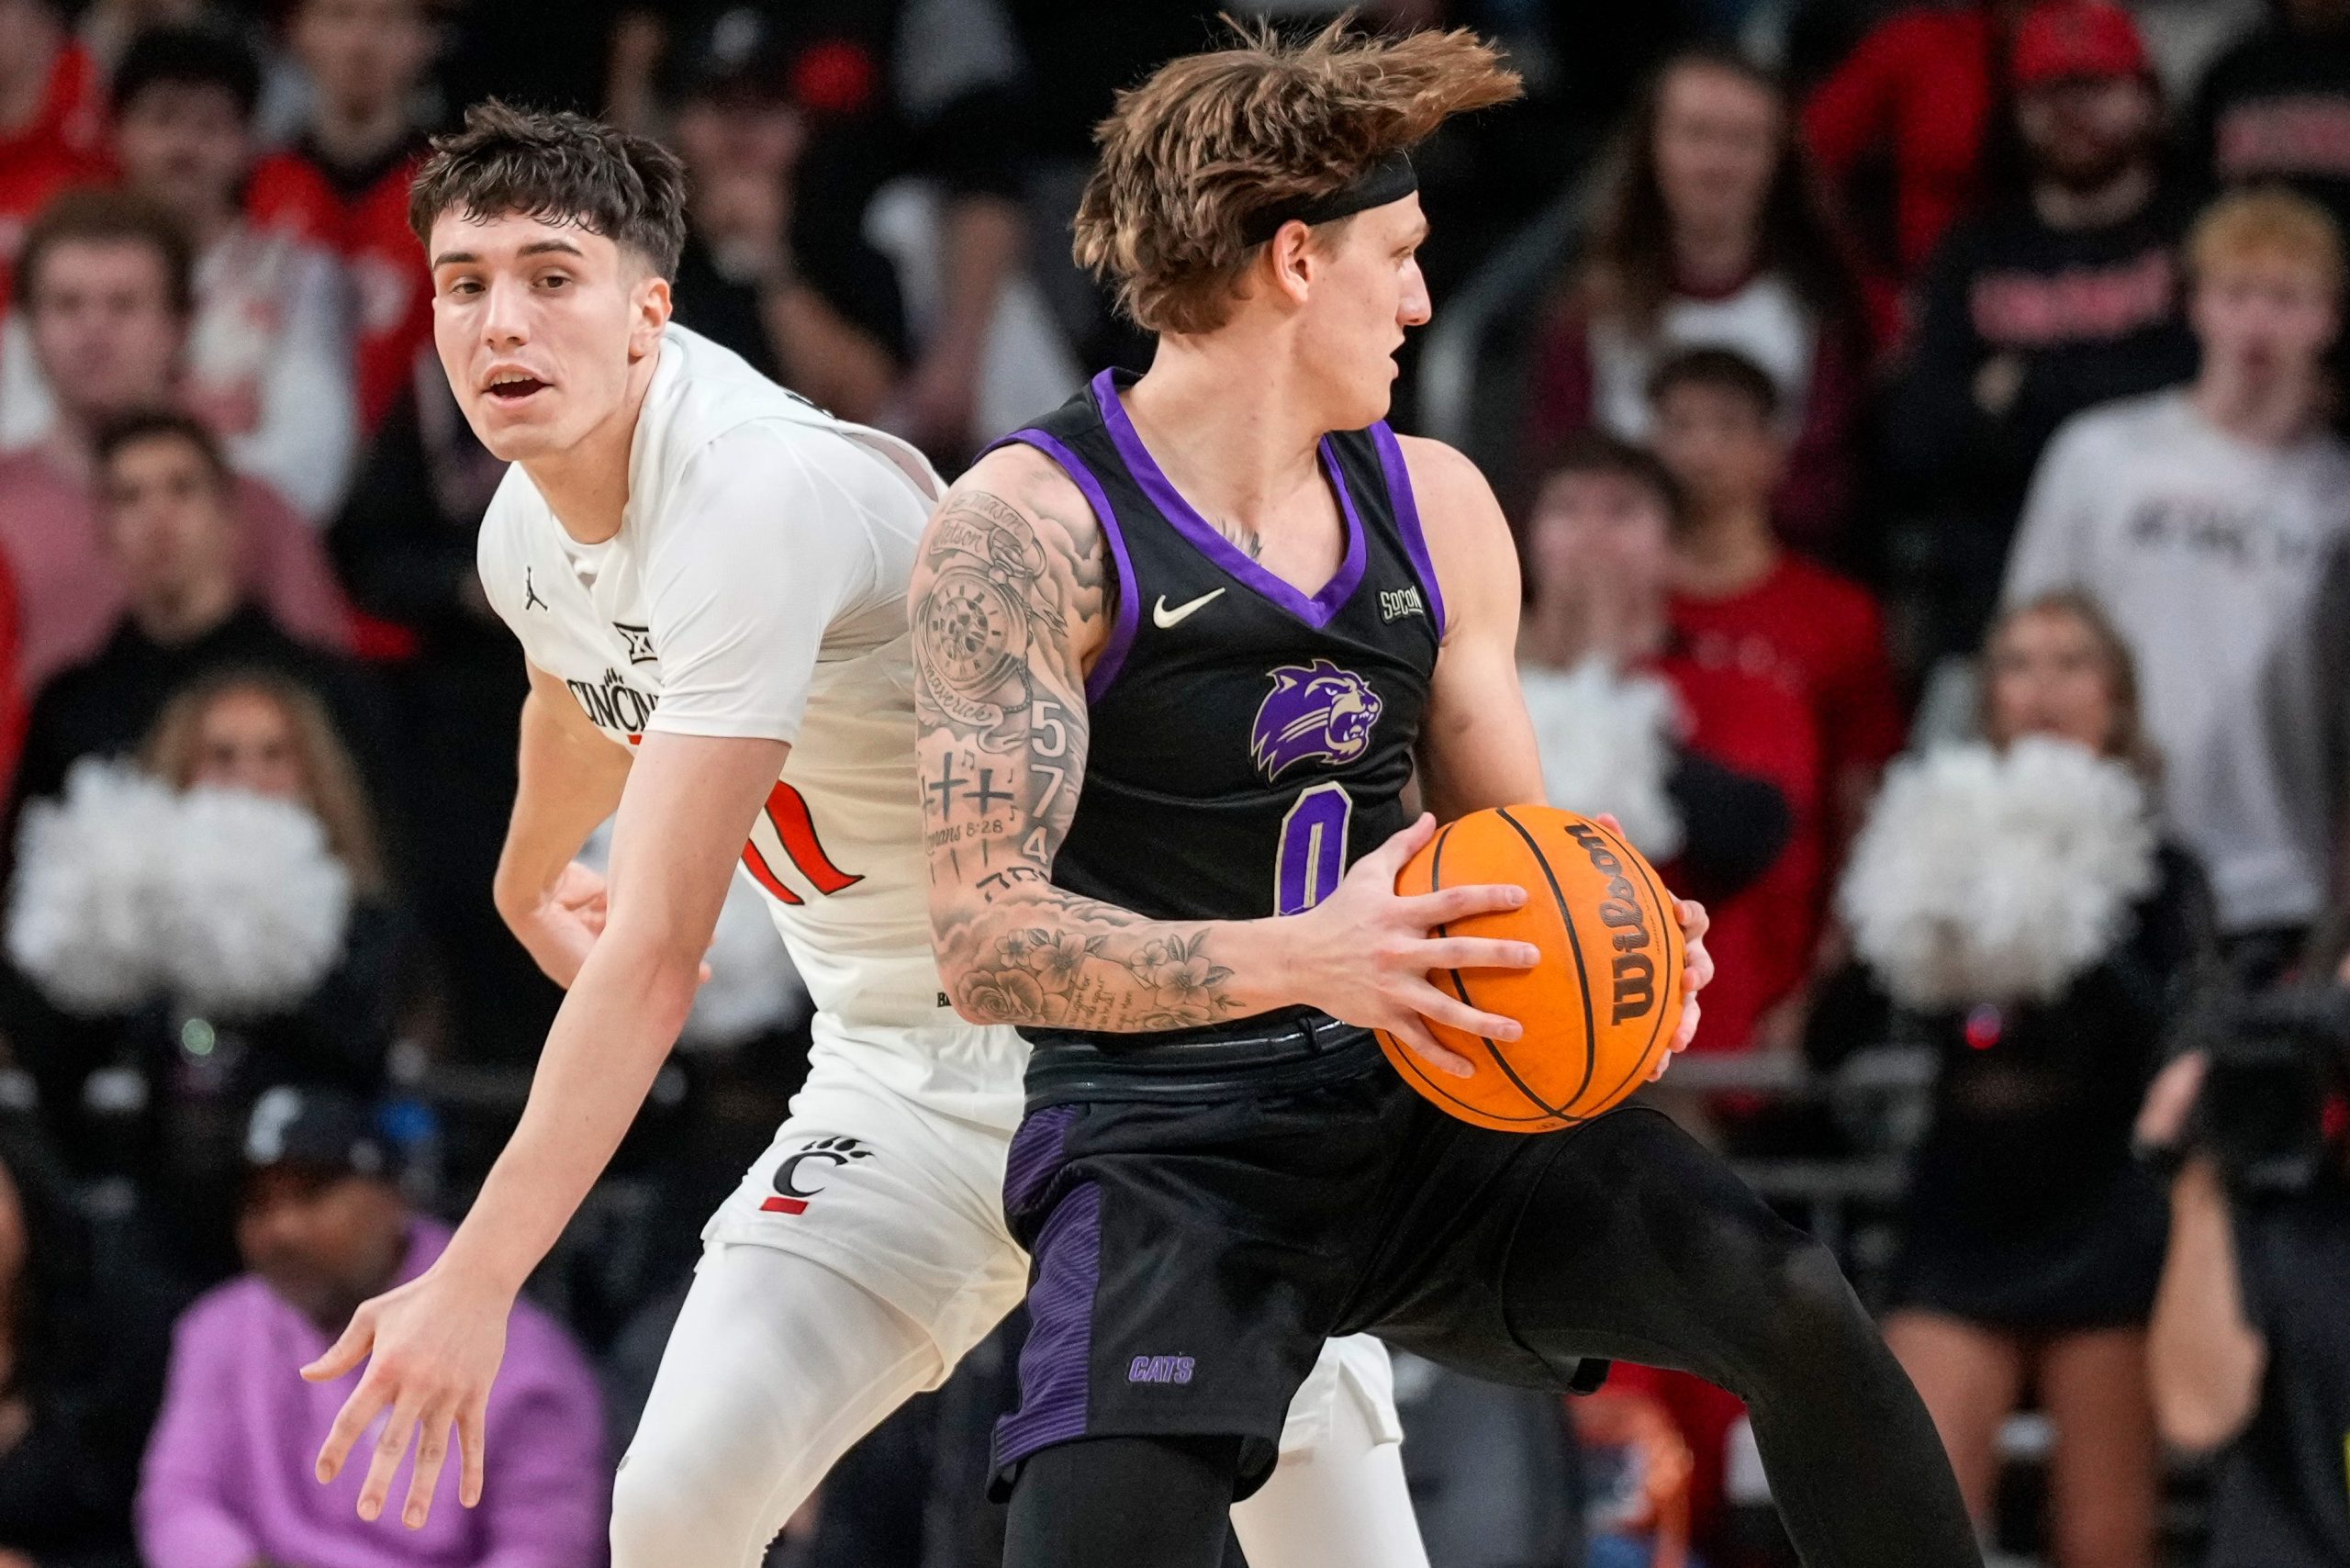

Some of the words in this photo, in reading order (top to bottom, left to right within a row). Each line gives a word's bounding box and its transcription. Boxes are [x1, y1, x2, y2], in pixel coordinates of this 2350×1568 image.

[1273, 780, 1353, 917] 0
[1562, 823, 1655, 1027] Wilson
[1128, 1355, 1195, 1383] CATS
